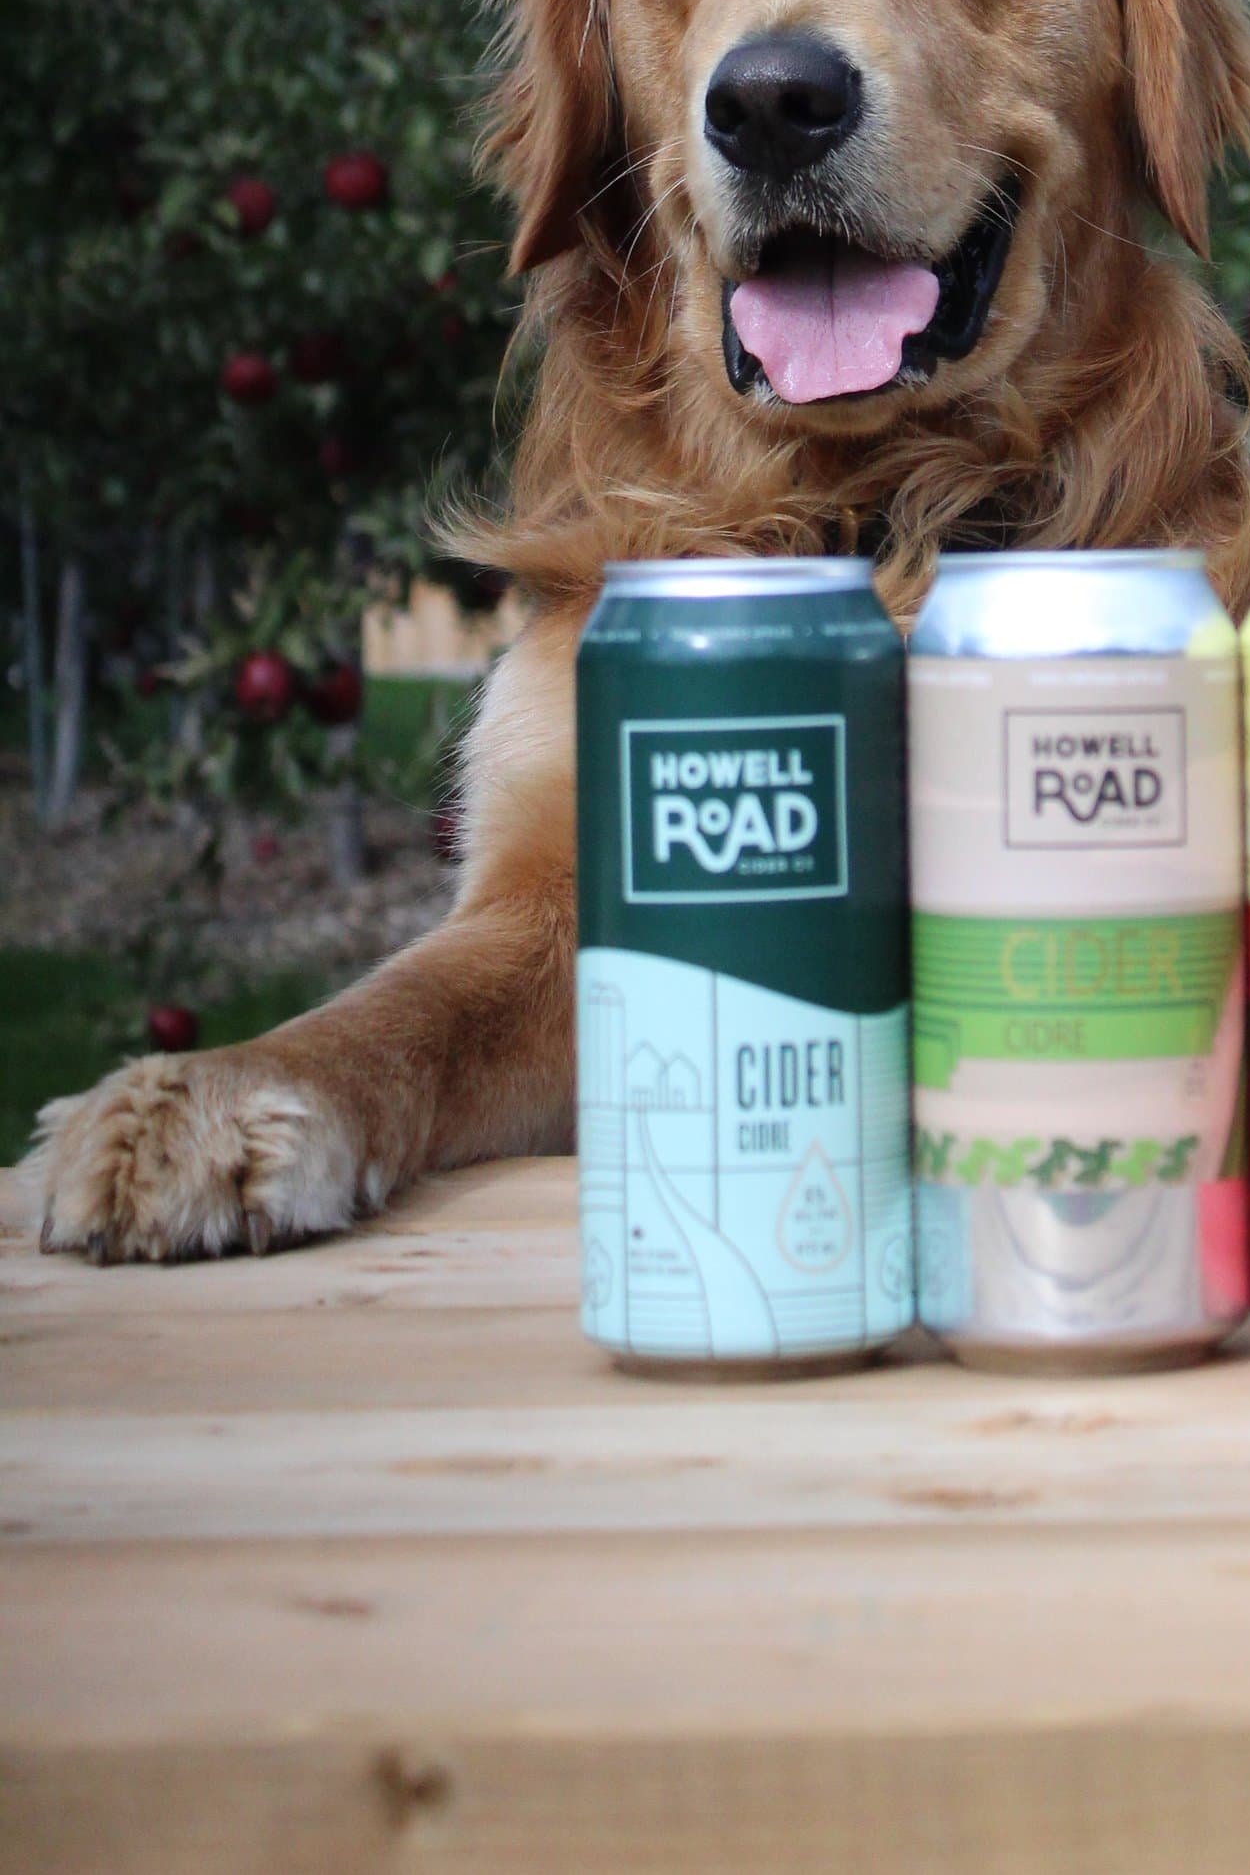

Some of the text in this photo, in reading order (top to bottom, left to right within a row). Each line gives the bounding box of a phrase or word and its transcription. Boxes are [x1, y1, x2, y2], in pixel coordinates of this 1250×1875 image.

[652, 749, 814, 790] HOWELL
[1031, 733, 1160, 758] HOWELL
[1034, 768, 1162, 824] ROAD
[654, 792, 818, 873] ROAD
[999, 927, 1183, 1001] CIDER
[1003, 1020, 1088, 1055] CIDRE
[736, 1036, 845, 1109] CIDER
[738, 1120, 792, 1153] CIDRE
